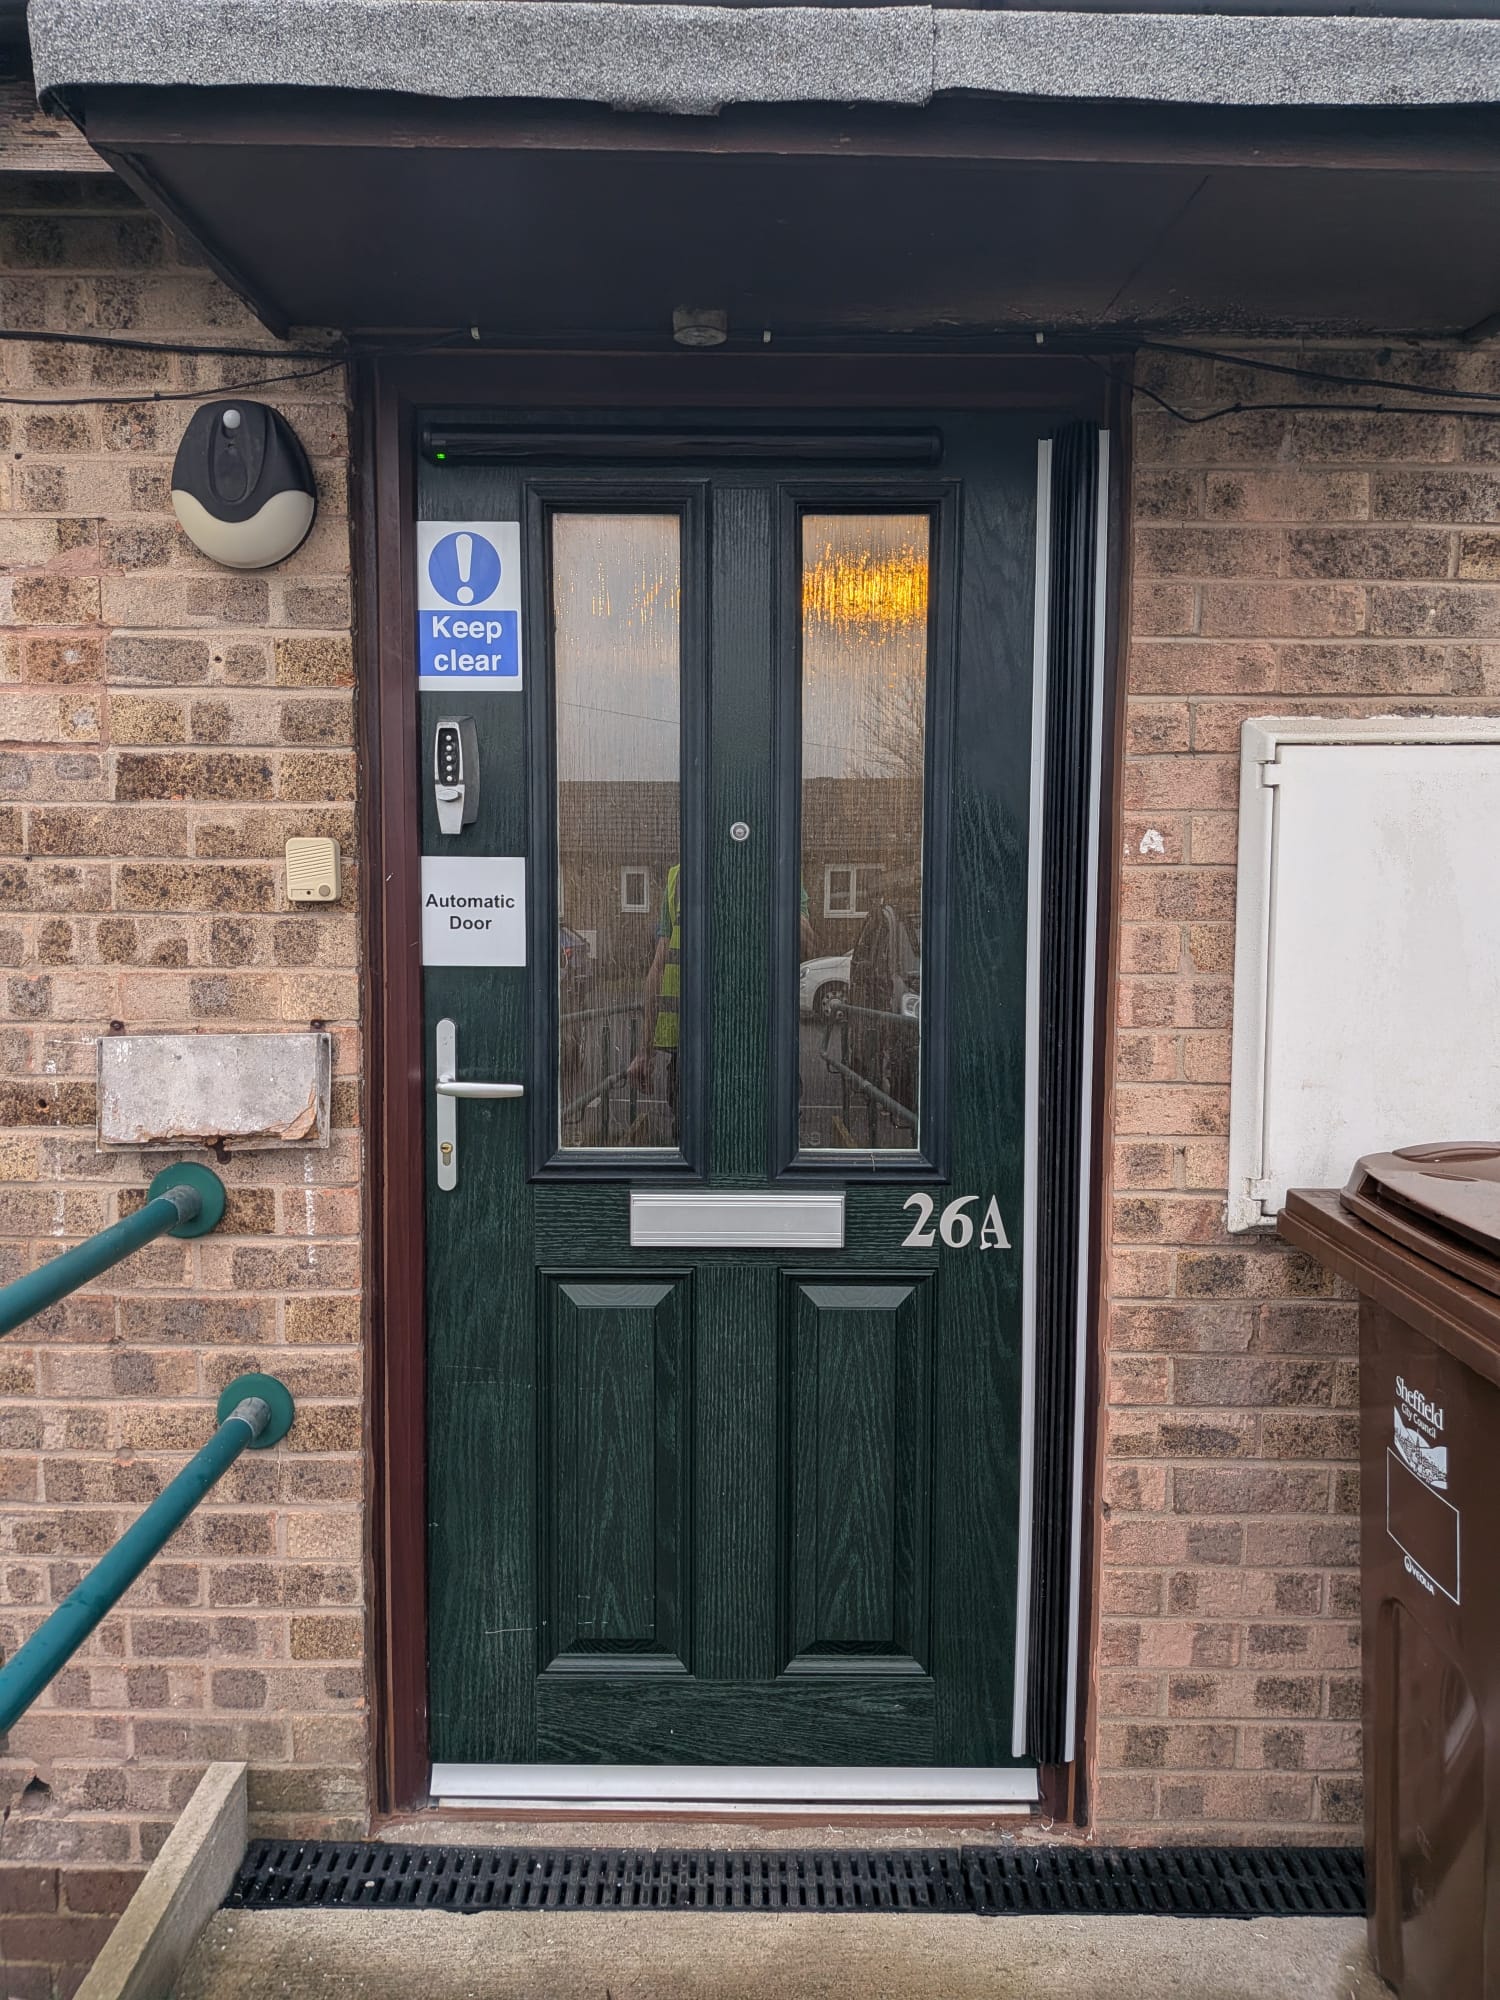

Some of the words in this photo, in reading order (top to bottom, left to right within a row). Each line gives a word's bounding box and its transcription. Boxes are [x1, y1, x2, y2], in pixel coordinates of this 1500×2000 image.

[432, 615, 503, 644] Keep
[434, 648, 502, 672] clear
[425, 893, 516, 909] Automatic
[449, 915, 493, 930] Door
[901, 1192, 1012, 1250] 26A
[1395, 1375, 1444, 1431] Sheffield
[1401, 1402, 1413, 1422] City
[1413, 1412, 1437, 1440] Council
